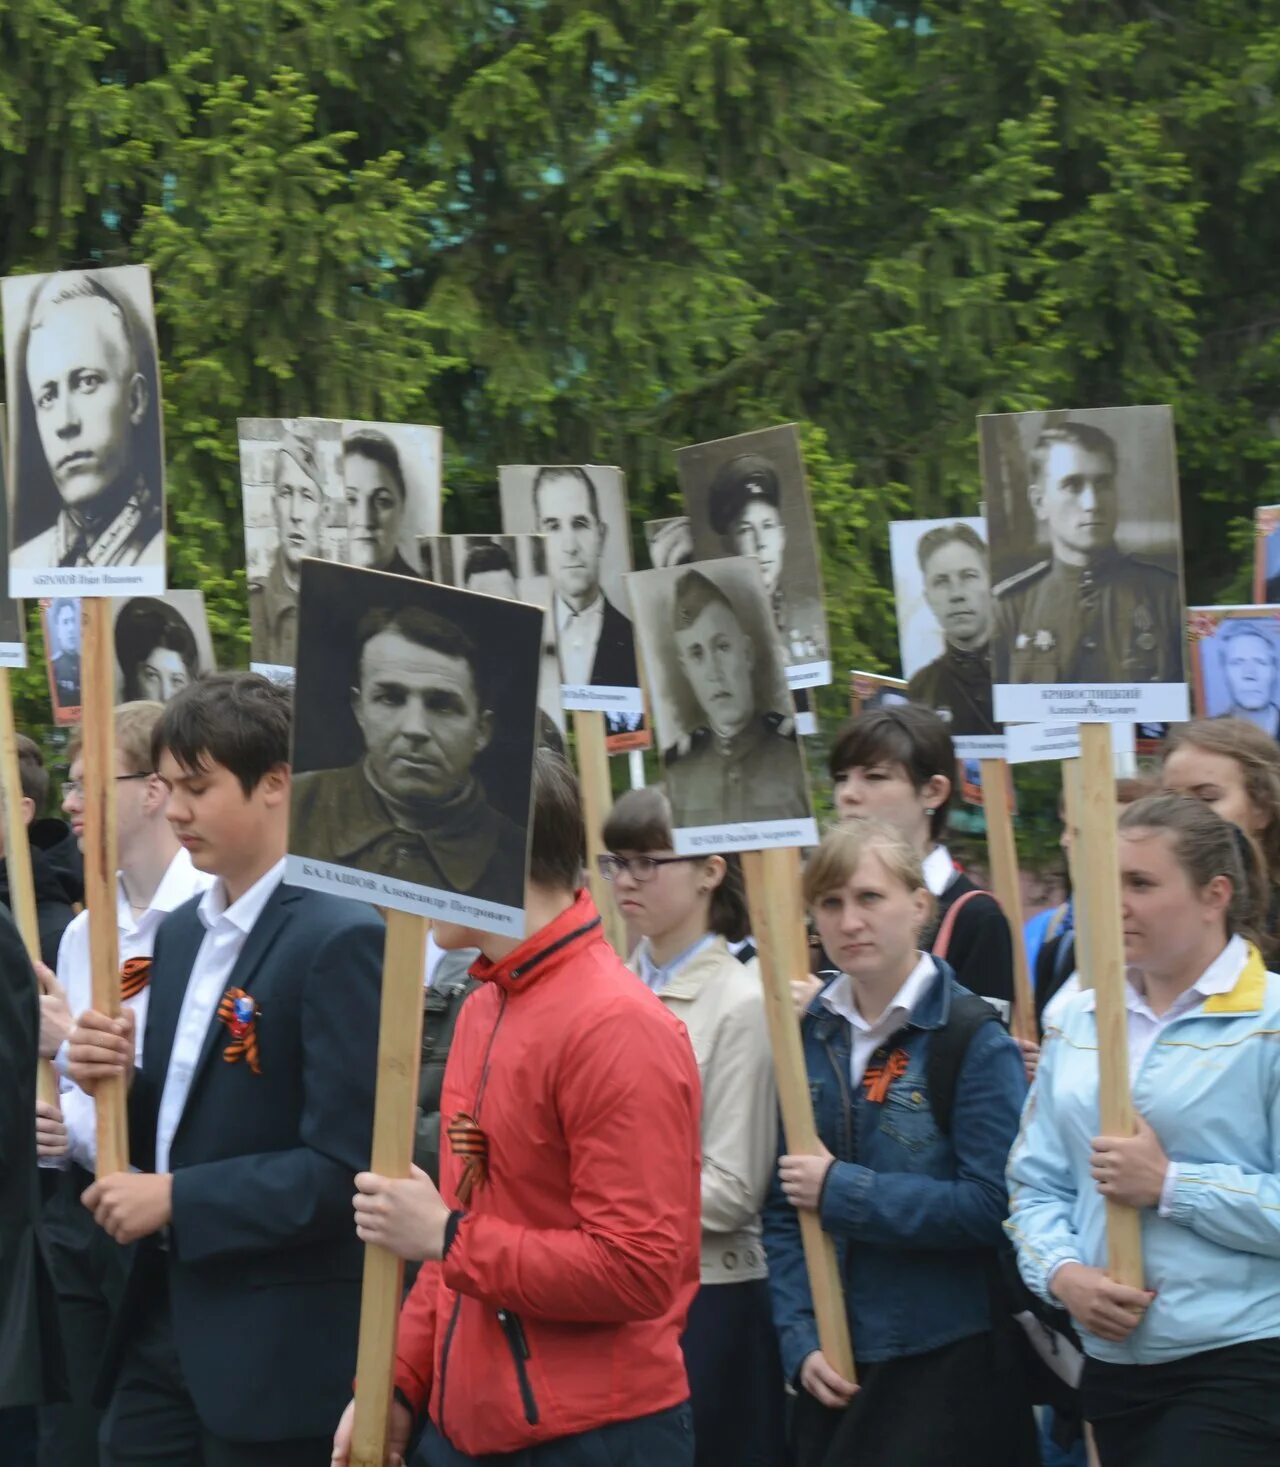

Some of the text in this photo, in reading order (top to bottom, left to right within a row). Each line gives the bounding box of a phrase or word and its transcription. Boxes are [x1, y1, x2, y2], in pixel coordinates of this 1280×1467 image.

[302, 864, 513, 924] БАЛАШОВ Александр Петрович
